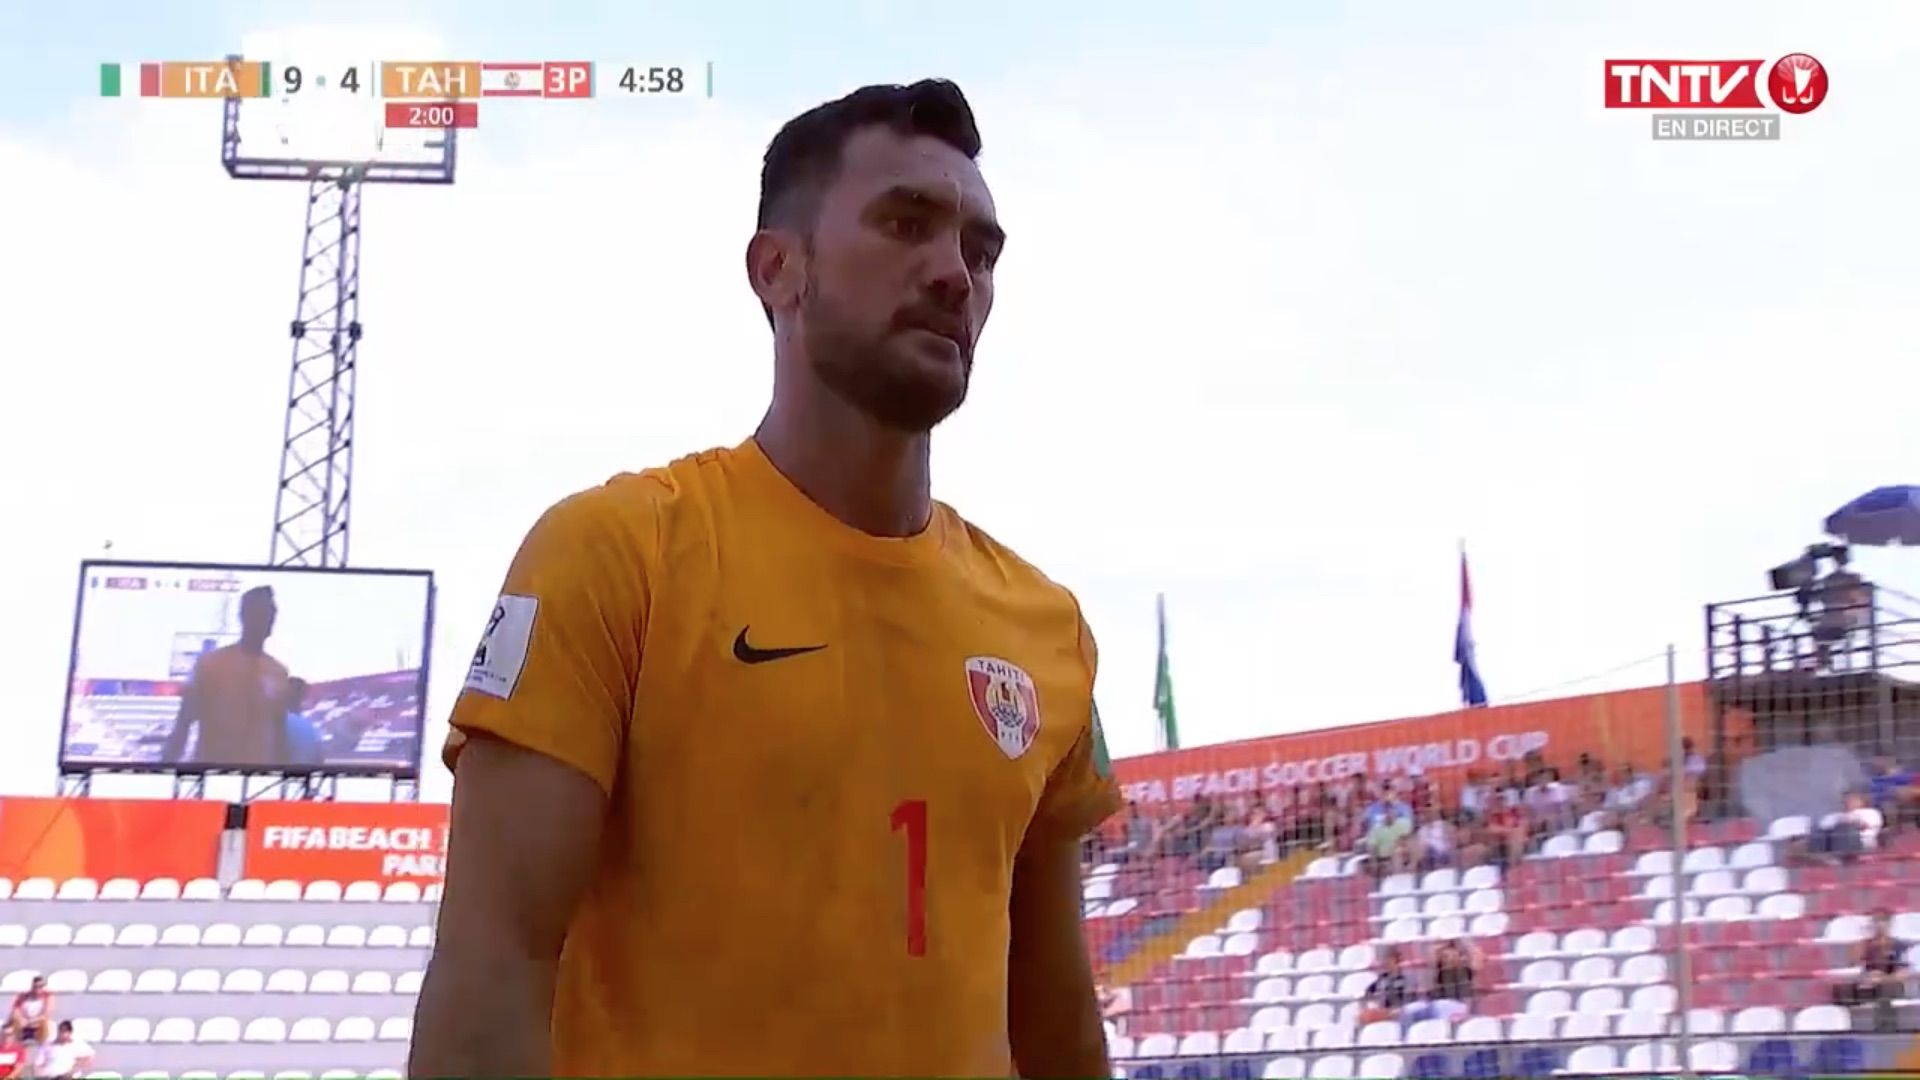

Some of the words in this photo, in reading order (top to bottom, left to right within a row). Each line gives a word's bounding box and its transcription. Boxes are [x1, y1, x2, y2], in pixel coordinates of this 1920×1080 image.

[1172, 767, 1258, 800] BEACH
[1263, 752, 1368, 788] SOCCER
[1374, 739, 1481, 773] WORLD
[1487, 731, 1549, 760] CUP
[262, 826, 327, 849] FIFA
[328, 826, 432, 850] BEACH
[382, 853, 446, 877] PAR
[888, 800, 927, 957] 1
